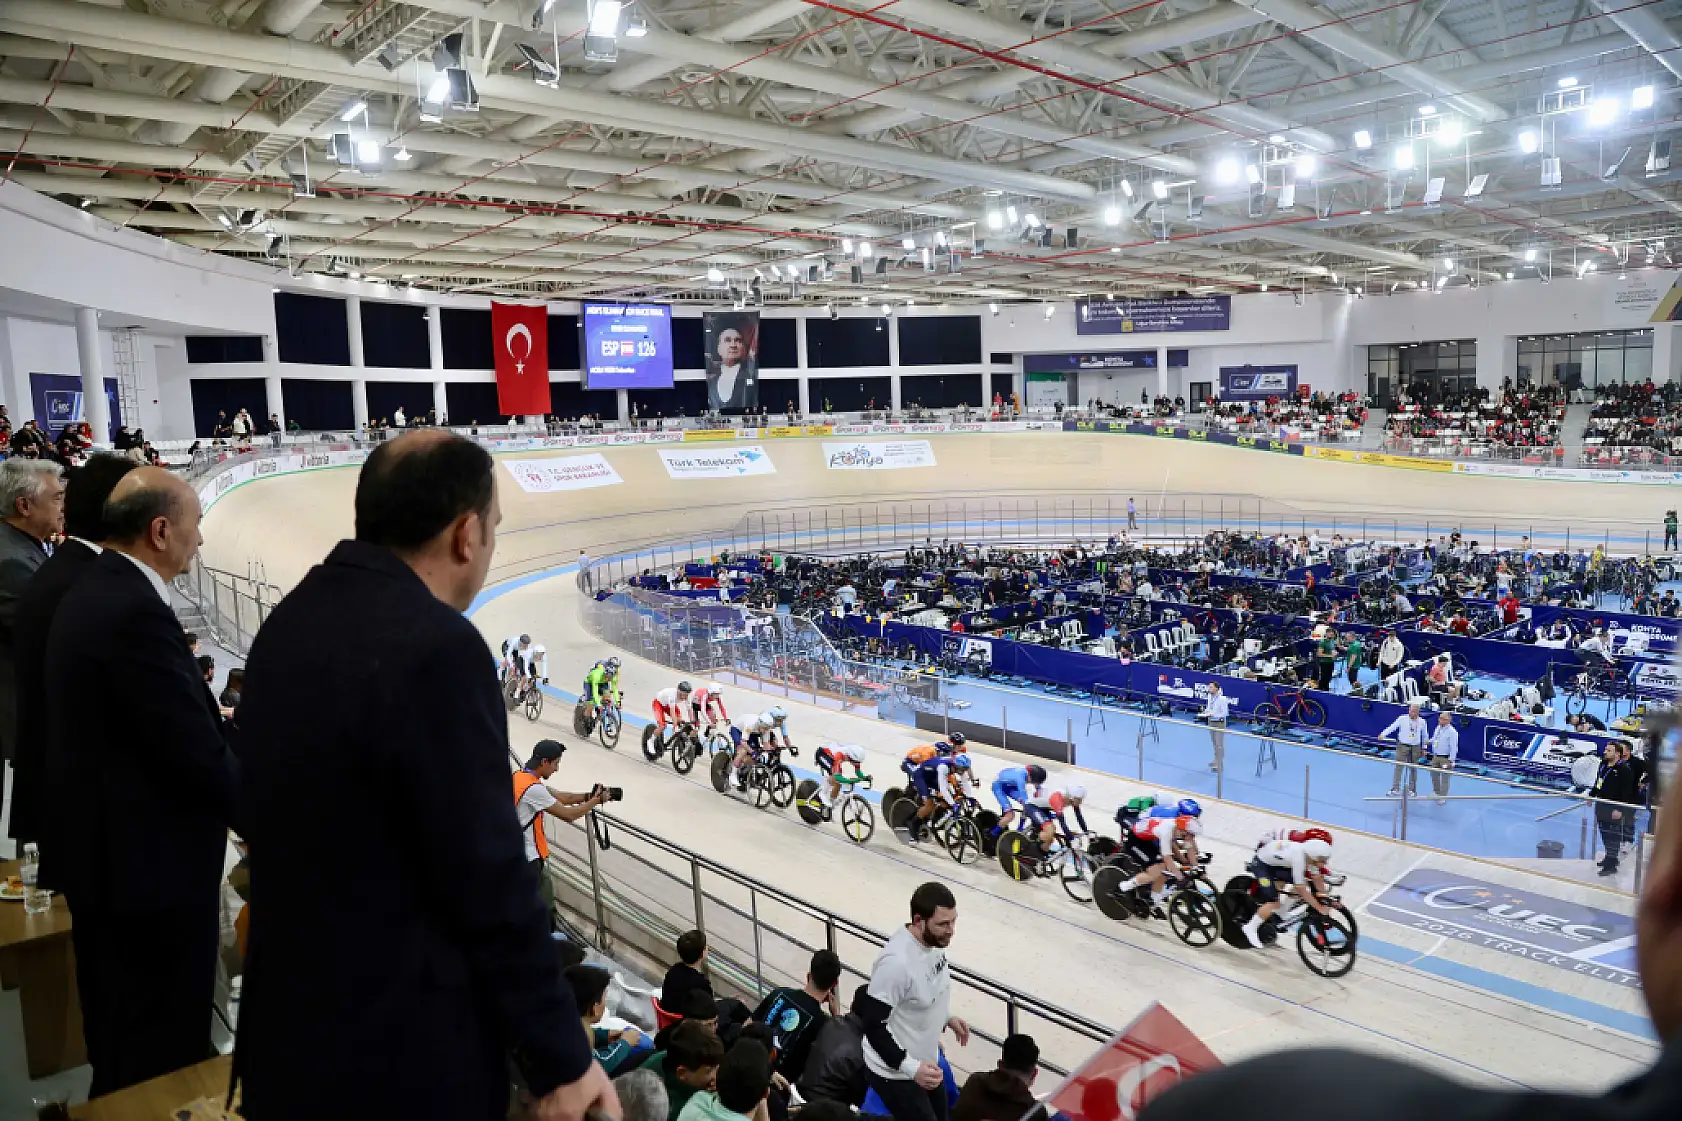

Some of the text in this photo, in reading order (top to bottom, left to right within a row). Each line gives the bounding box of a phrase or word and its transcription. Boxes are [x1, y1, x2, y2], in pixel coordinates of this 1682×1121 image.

[601, 341, 656, 356] ESP 126
[1631, 624, 1661, 633] KONYA
[1412, 920, 1474, 940] 2026
[1484, 937, 1567, 964] TRACK
